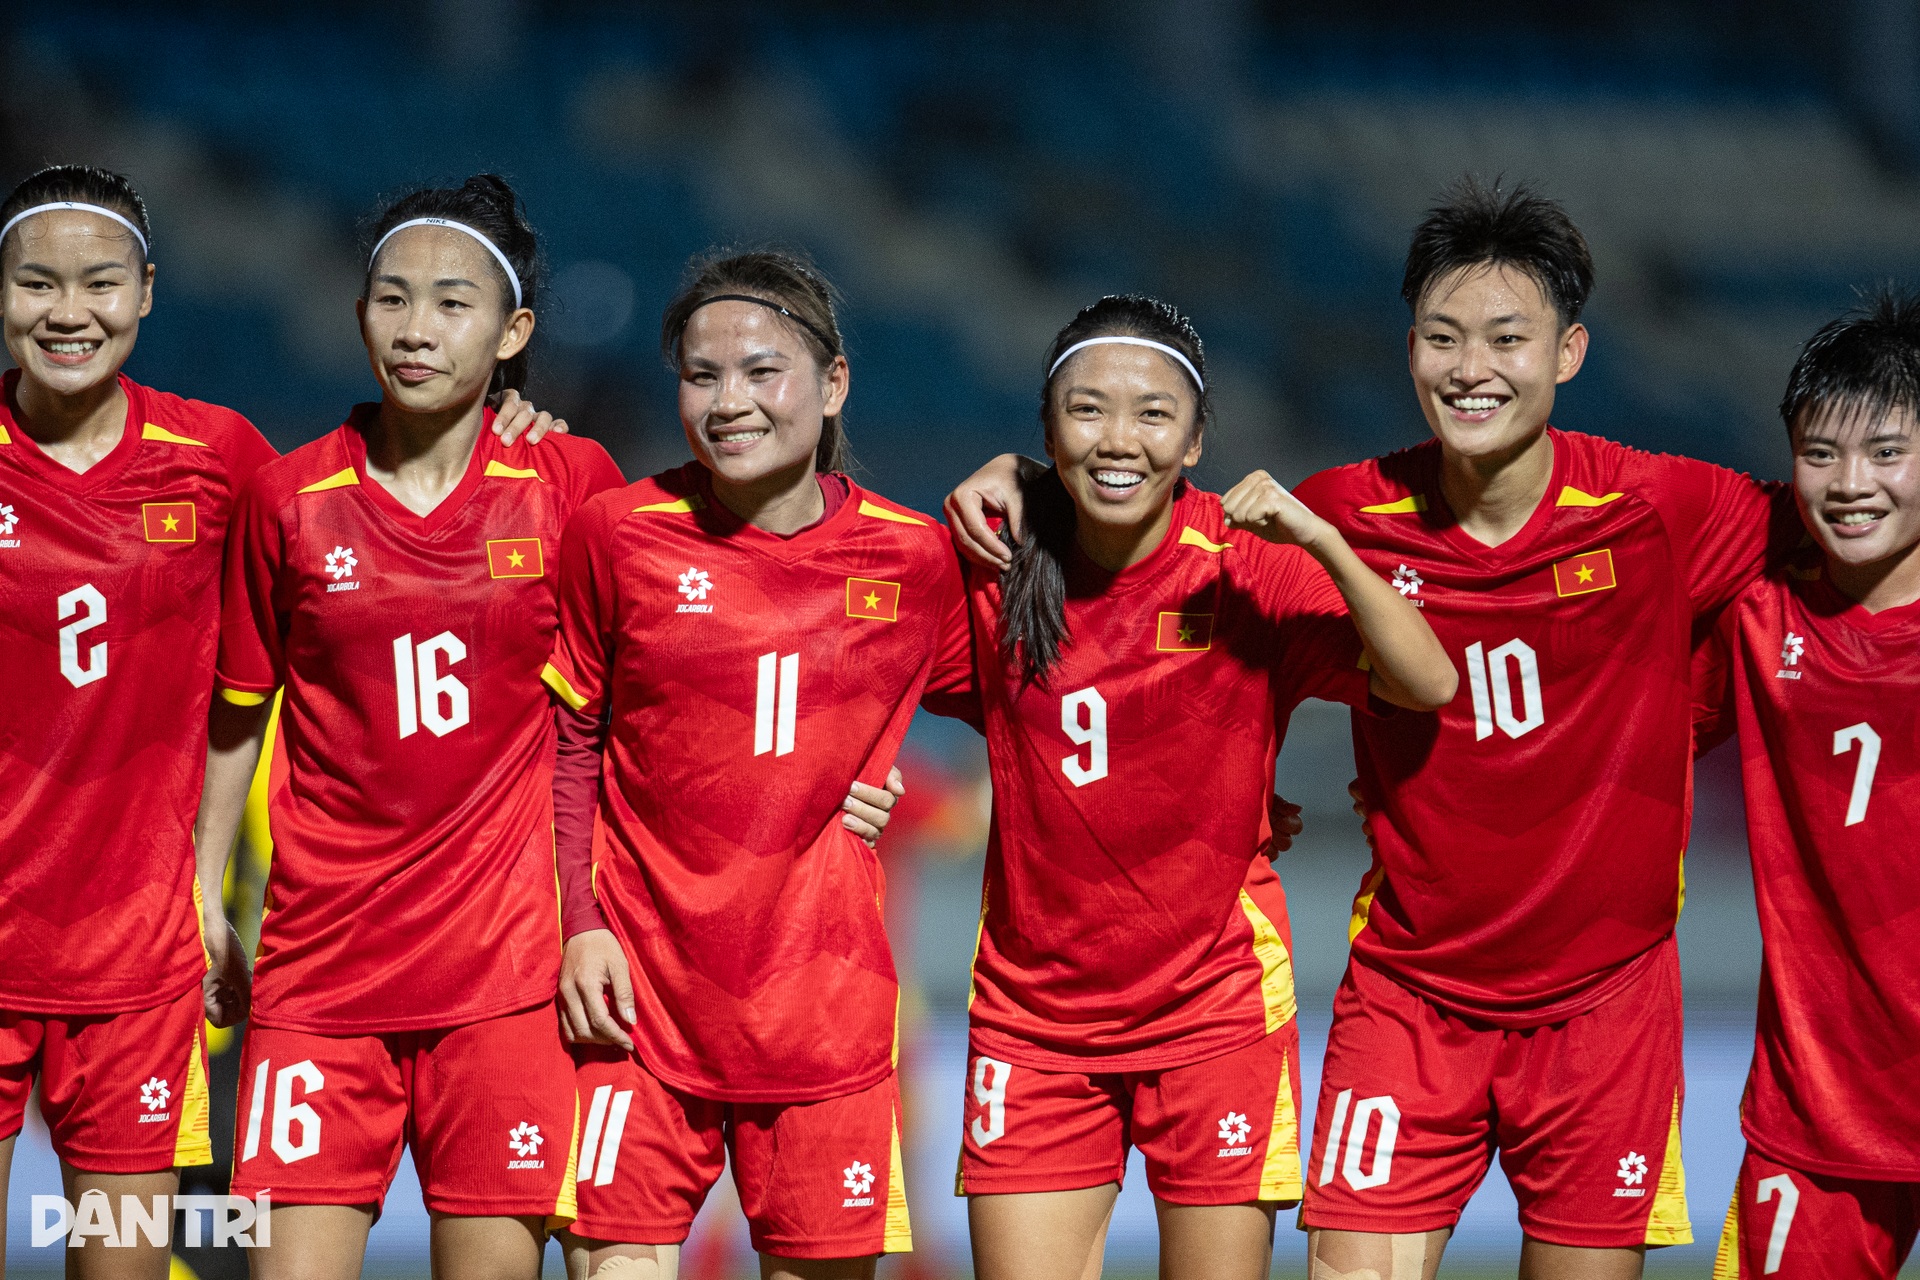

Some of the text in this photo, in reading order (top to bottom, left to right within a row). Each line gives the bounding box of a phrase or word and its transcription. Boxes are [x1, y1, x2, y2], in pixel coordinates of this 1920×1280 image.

[57, 583, 108, 688] 2
[675, 604, 714, 613] JOGARBOLA
[392, 630, 470, 739] 16
[753, 650, 800, 757] 11
[1061, 686, 1109, 787] 9
[1465, 637, 1545, 741] 10
[1833, 721, 1882, 827] 7
[241, 1058, 325, 1165] 16
[576, 1084, 634, 1187] 11
[971, 1056, 1013, 1148] 9
[1318, 1088, 1402, 1192] 10
[507, 1160, 545, 1169] JOGARBOLA
[1757, 1173, 1800, 1274] 7
